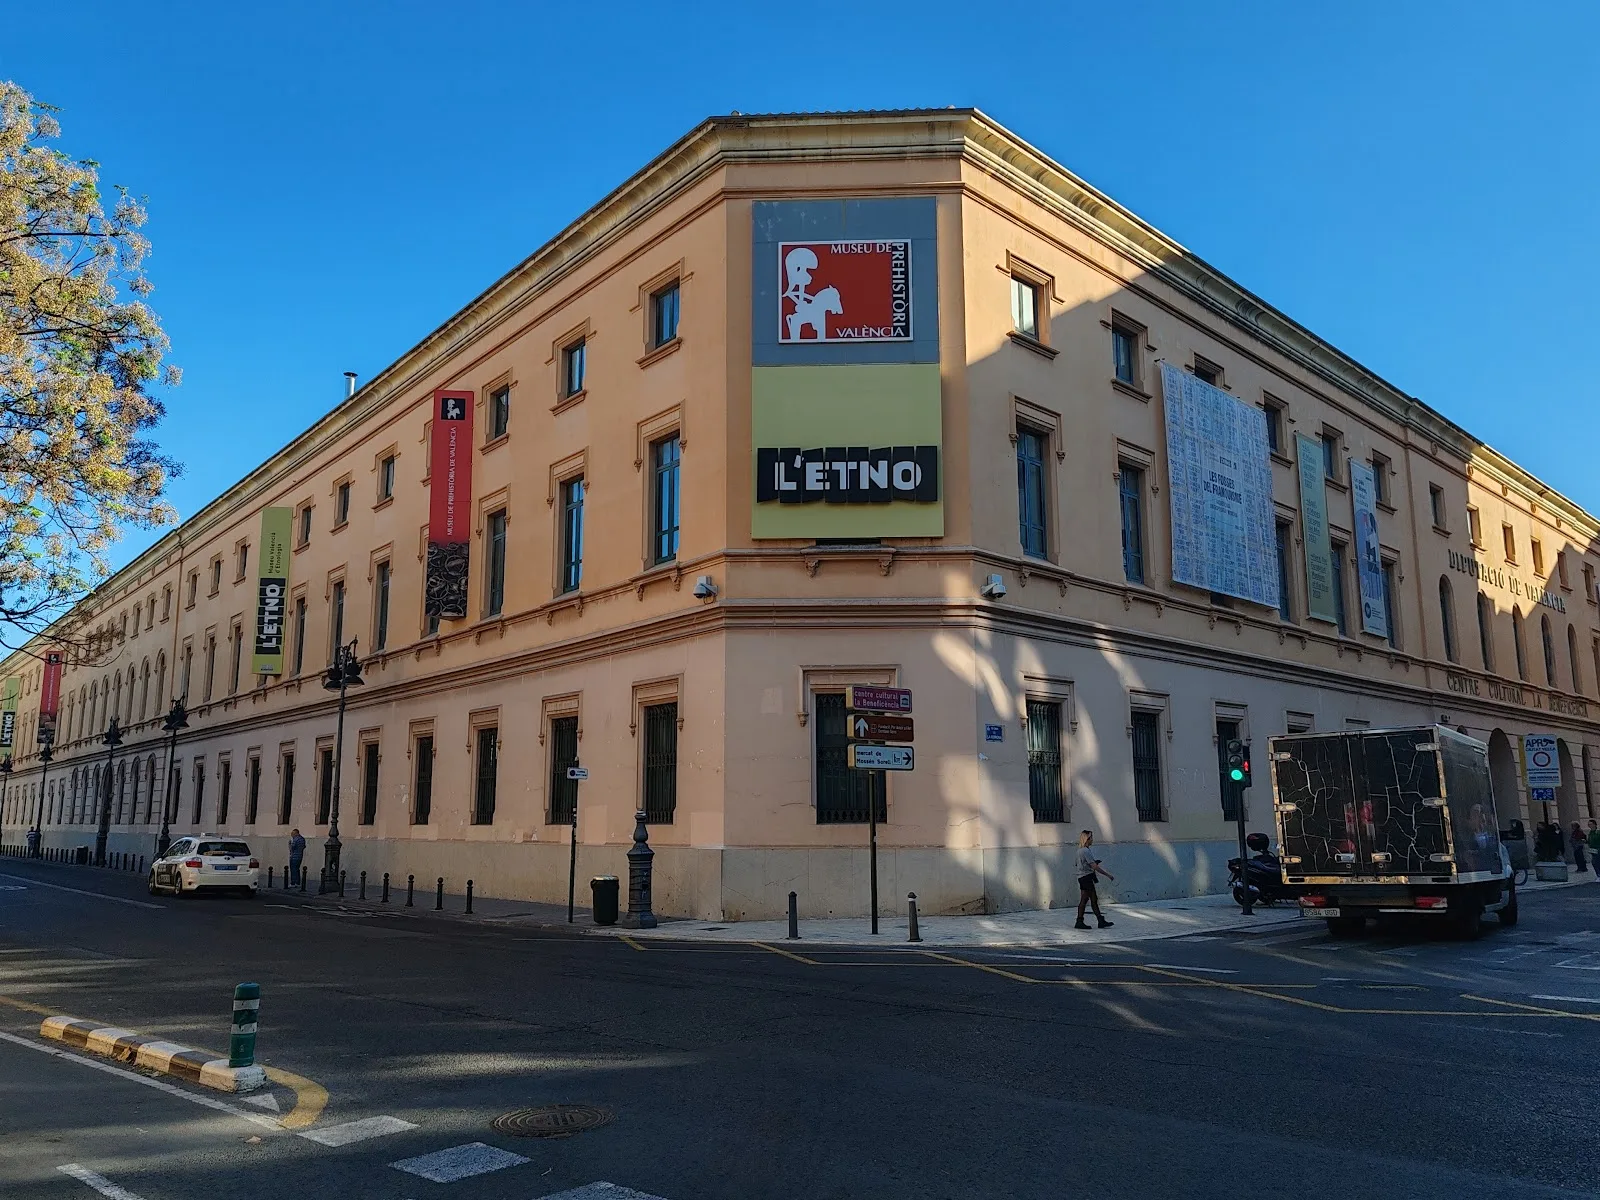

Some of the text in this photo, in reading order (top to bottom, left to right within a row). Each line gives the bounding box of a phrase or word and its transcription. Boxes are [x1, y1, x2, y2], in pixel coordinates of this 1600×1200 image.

[830, 242, 892, 255] MUSEU DE
[835, 324, 905, 338] VALÈNCIA
[449, 426, 457, 458] VALÈNCIA
[449, 458, 456, 467] DE
[774, 454, 922, 491] L'ETNO
[447, 505, 454, 514] DE
[267, 556, 275, 574] Museu
[1448, 548, 1505, 589] DIPUTACIÓ
[1508, 575, 1522, 596] DE
[260, 584, 280, 648] L'ETNO
[875, 691, 899, 700] cultural
[1446, 672, 1481, 697] CENTRE
[1488, 681, 1527, 706] CULTURAL
[1532, 691, 1542, 709] LA
[854, 698, 860, 706] la
